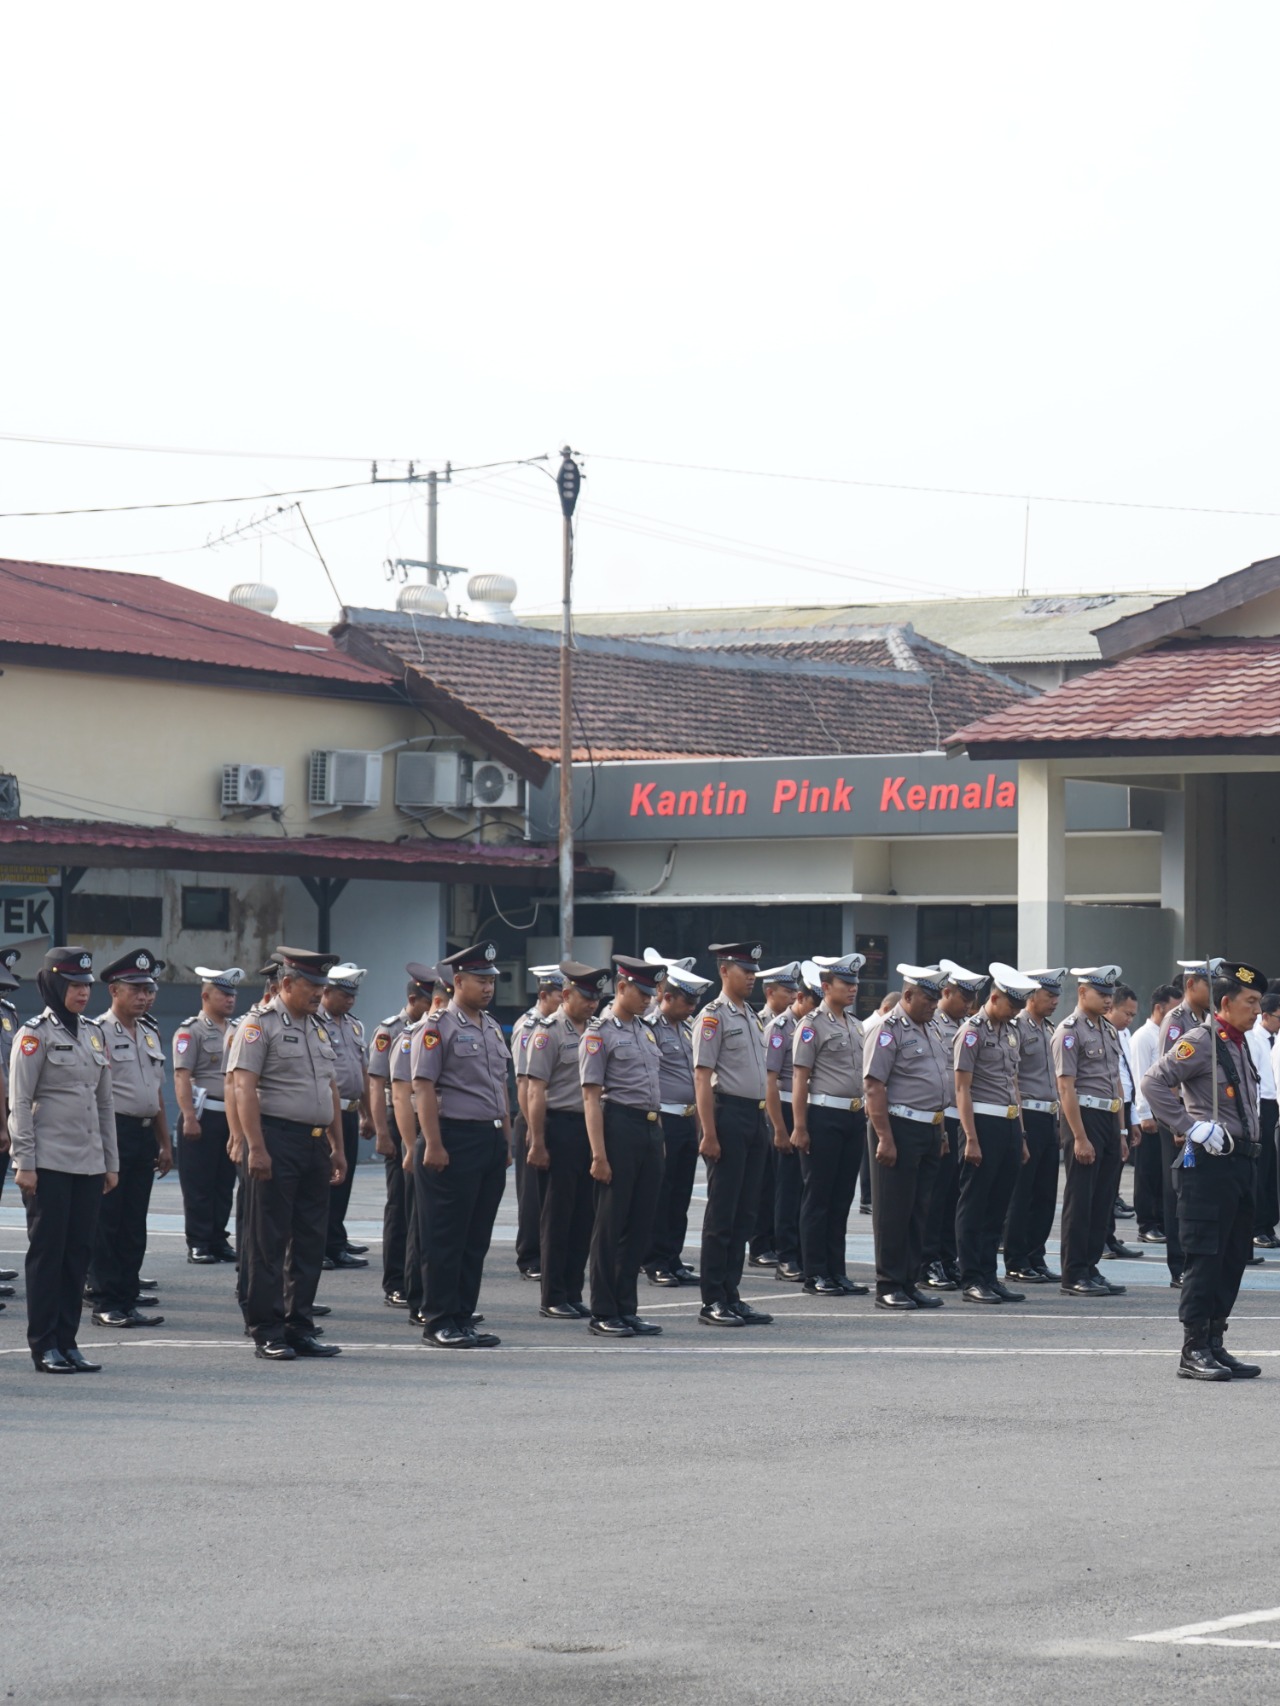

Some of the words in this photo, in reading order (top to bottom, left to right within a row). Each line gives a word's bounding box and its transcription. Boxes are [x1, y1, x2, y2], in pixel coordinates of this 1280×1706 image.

[630, 782, 747, 816] Kantin
[773, 778, 854, 813] Pink
[880, 774, 1016, 812] Kemala
[0, 899, 50, 934] EK
